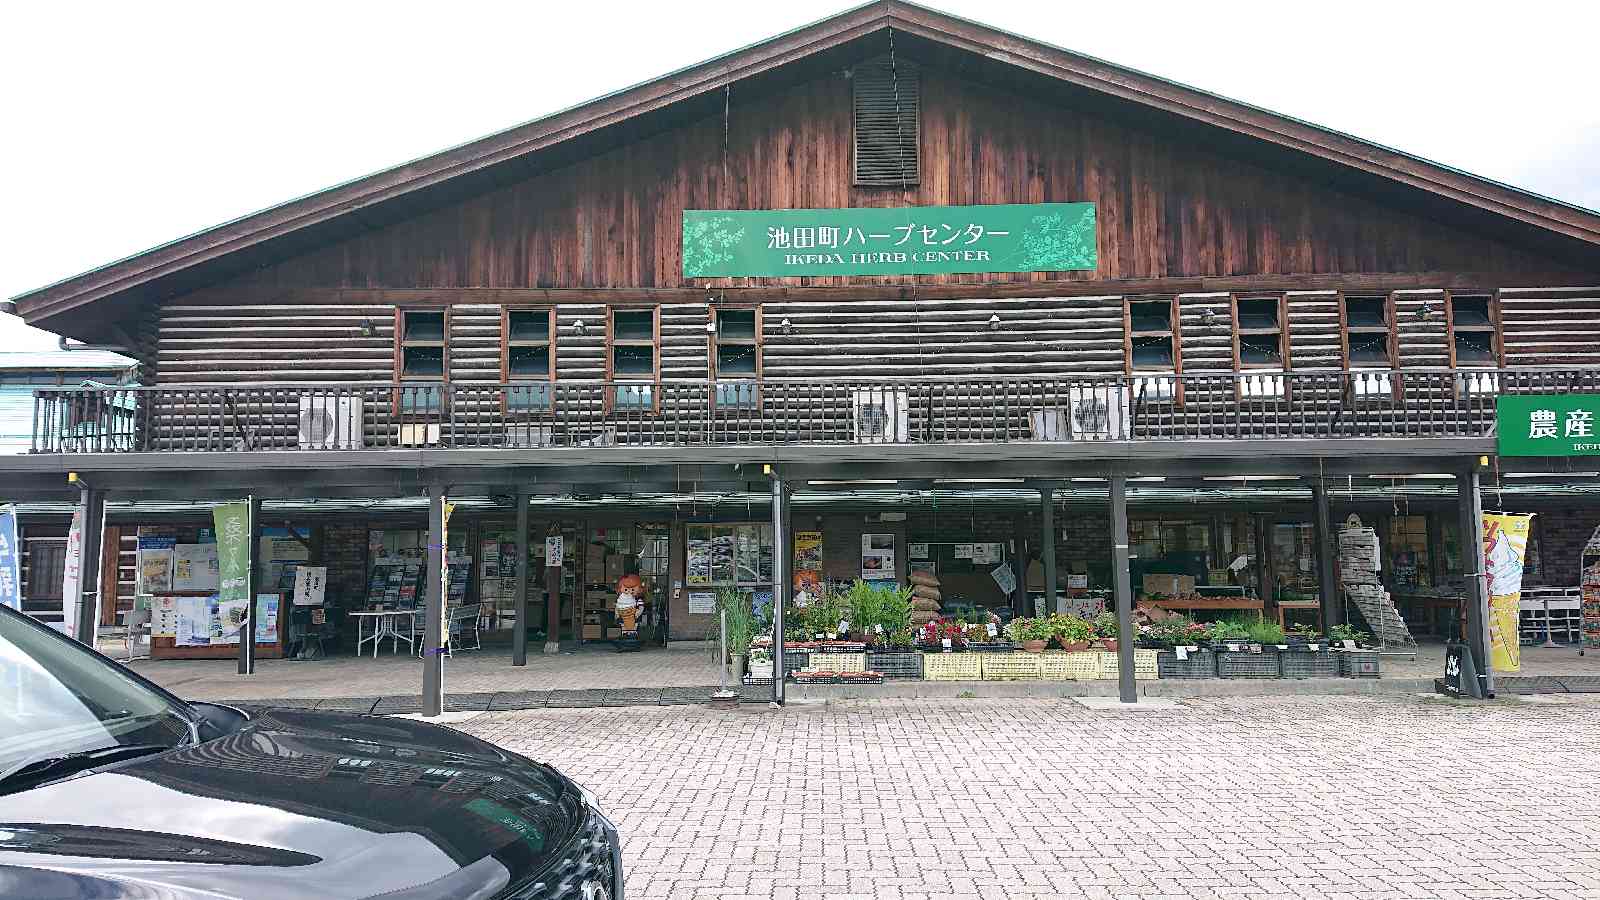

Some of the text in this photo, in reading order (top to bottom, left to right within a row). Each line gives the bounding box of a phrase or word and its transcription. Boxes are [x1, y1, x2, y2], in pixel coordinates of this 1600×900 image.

[767, 224, 1009, 249] 池田町ハーブセンター
[784, 250, 990, 265] IKEDA HERB CENTER
[1528, 409, 1594, 439] 農産
